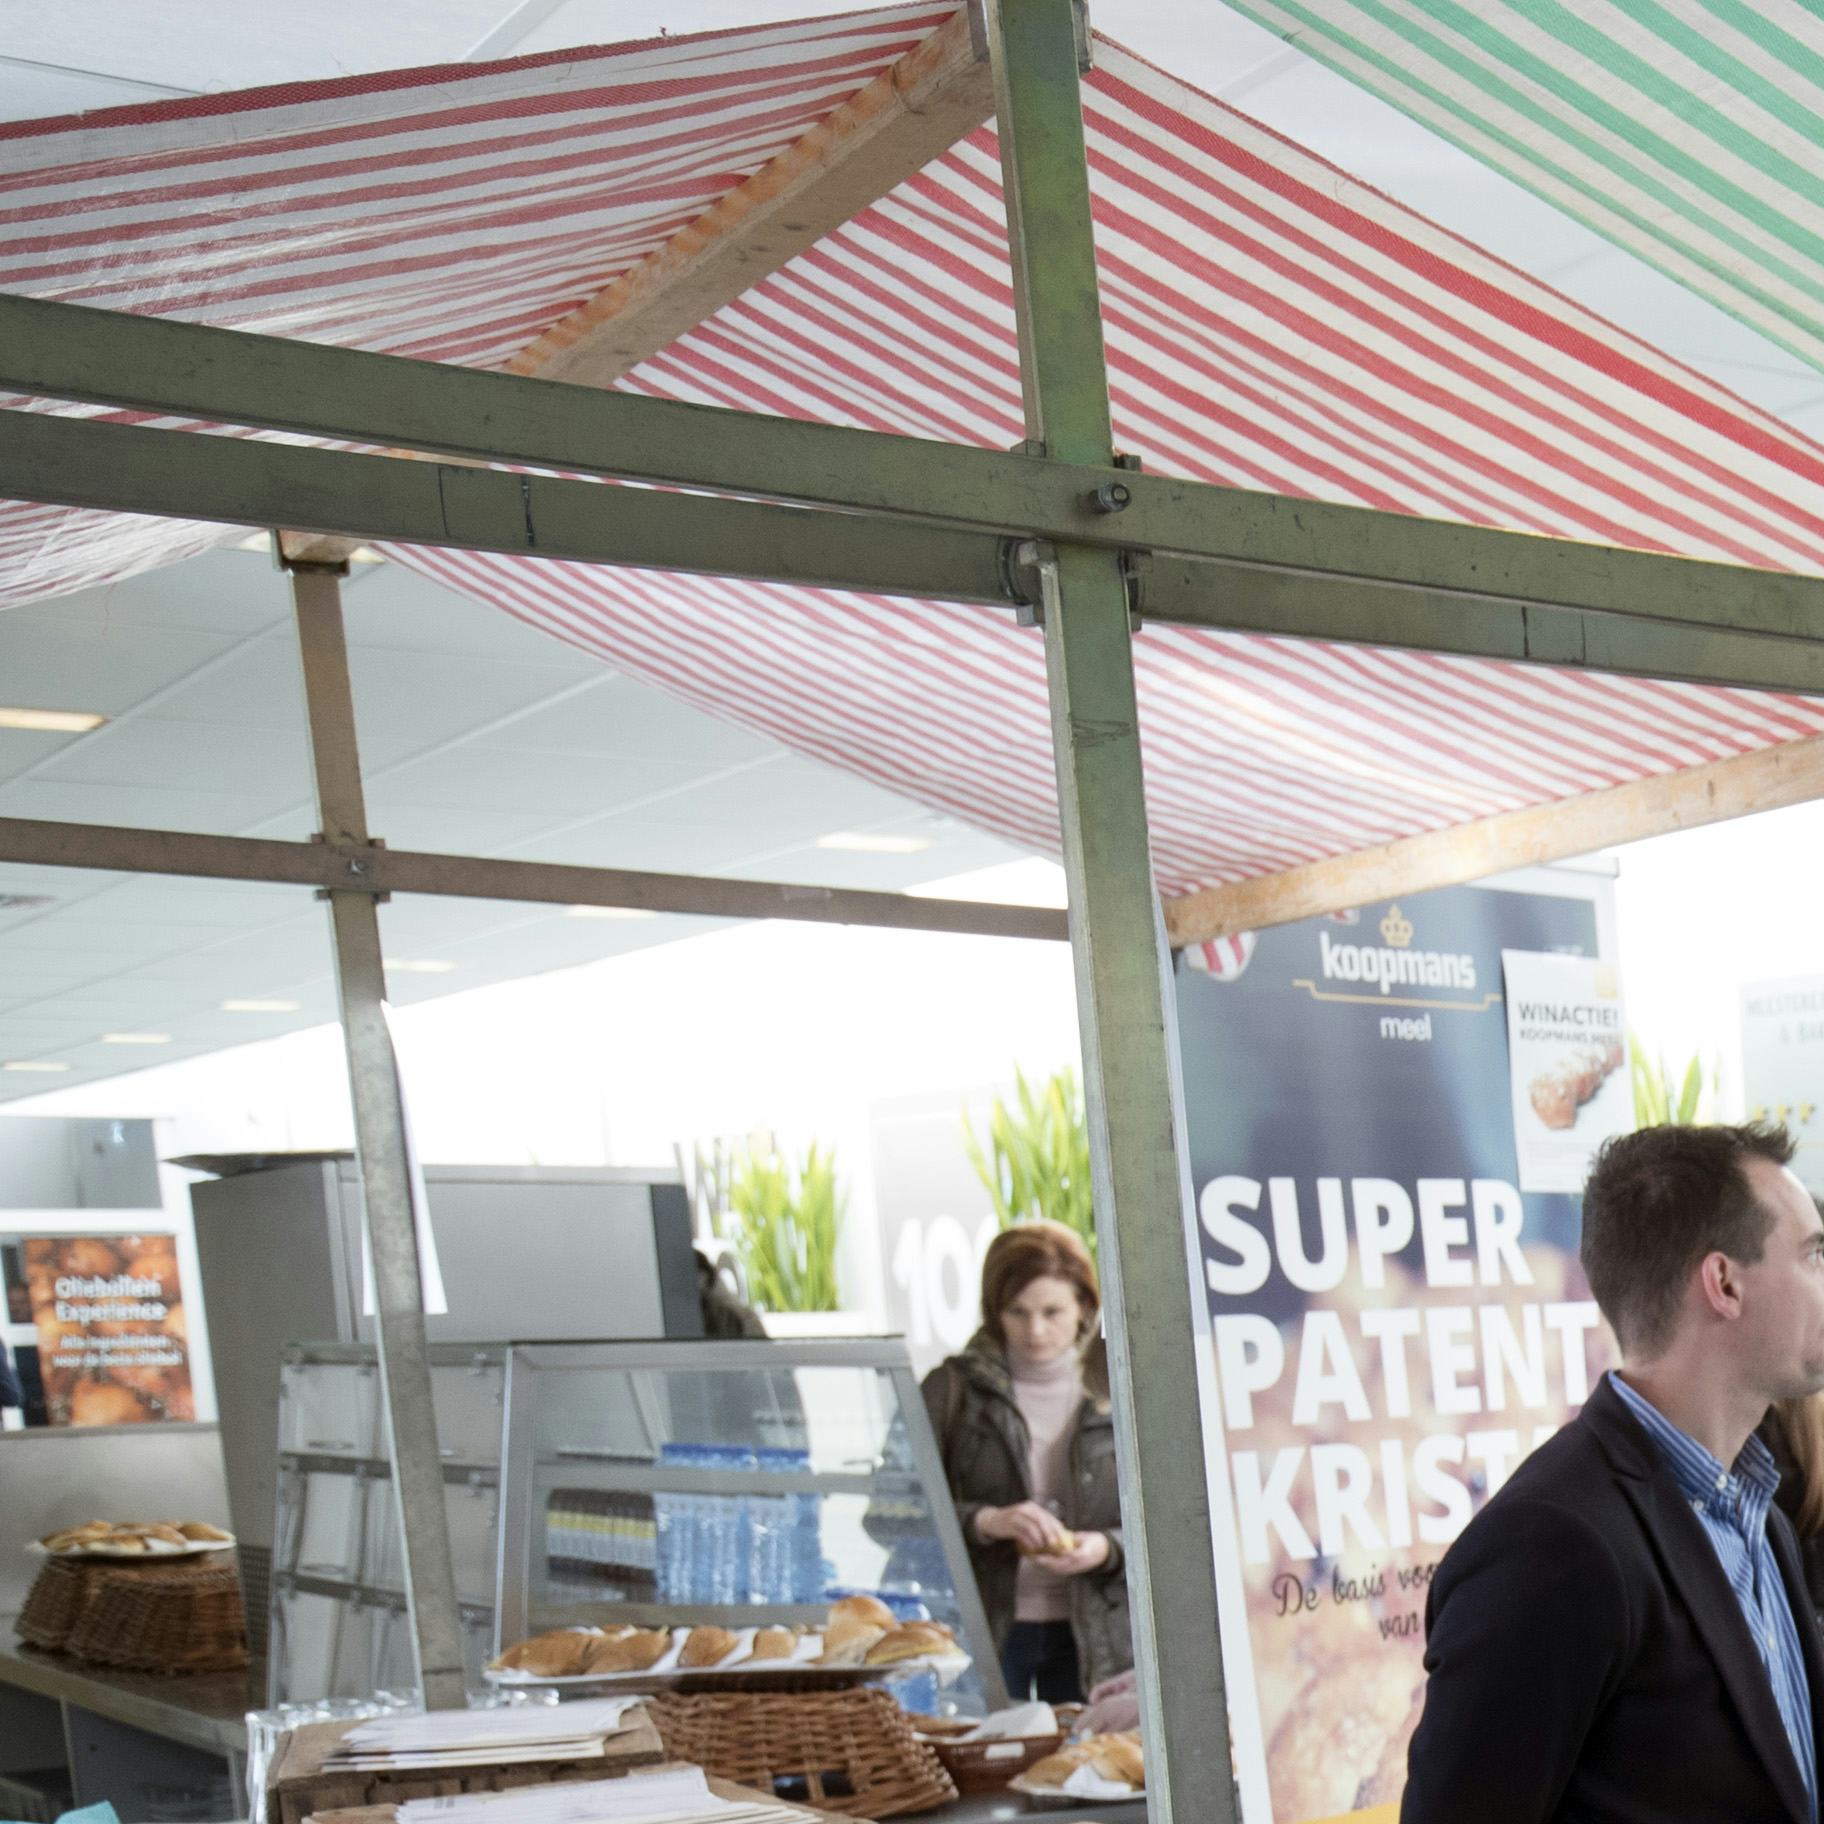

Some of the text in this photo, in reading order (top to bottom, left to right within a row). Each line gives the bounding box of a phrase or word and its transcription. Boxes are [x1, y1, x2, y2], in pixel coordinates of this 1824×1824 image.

[1320, 931, 1476, 994] koopmans
[1380, 1013, 1432, 1042] meel
[1517, 1001, 1618, 1027] WINACTIE!
[1200, 1175, 1534, 1295] SUPER
[55, 1274, 162, 1299] Oliebollen
[55, 1300, 168, 1326] Experience
[1213, 1301, 1601, 1430] PATENT
[1231, 1424, 1560, 1565] KRIST
[1273, 1560, 1438, 1618] De basis voo
[1378, 1611, 1420, 1641] van
